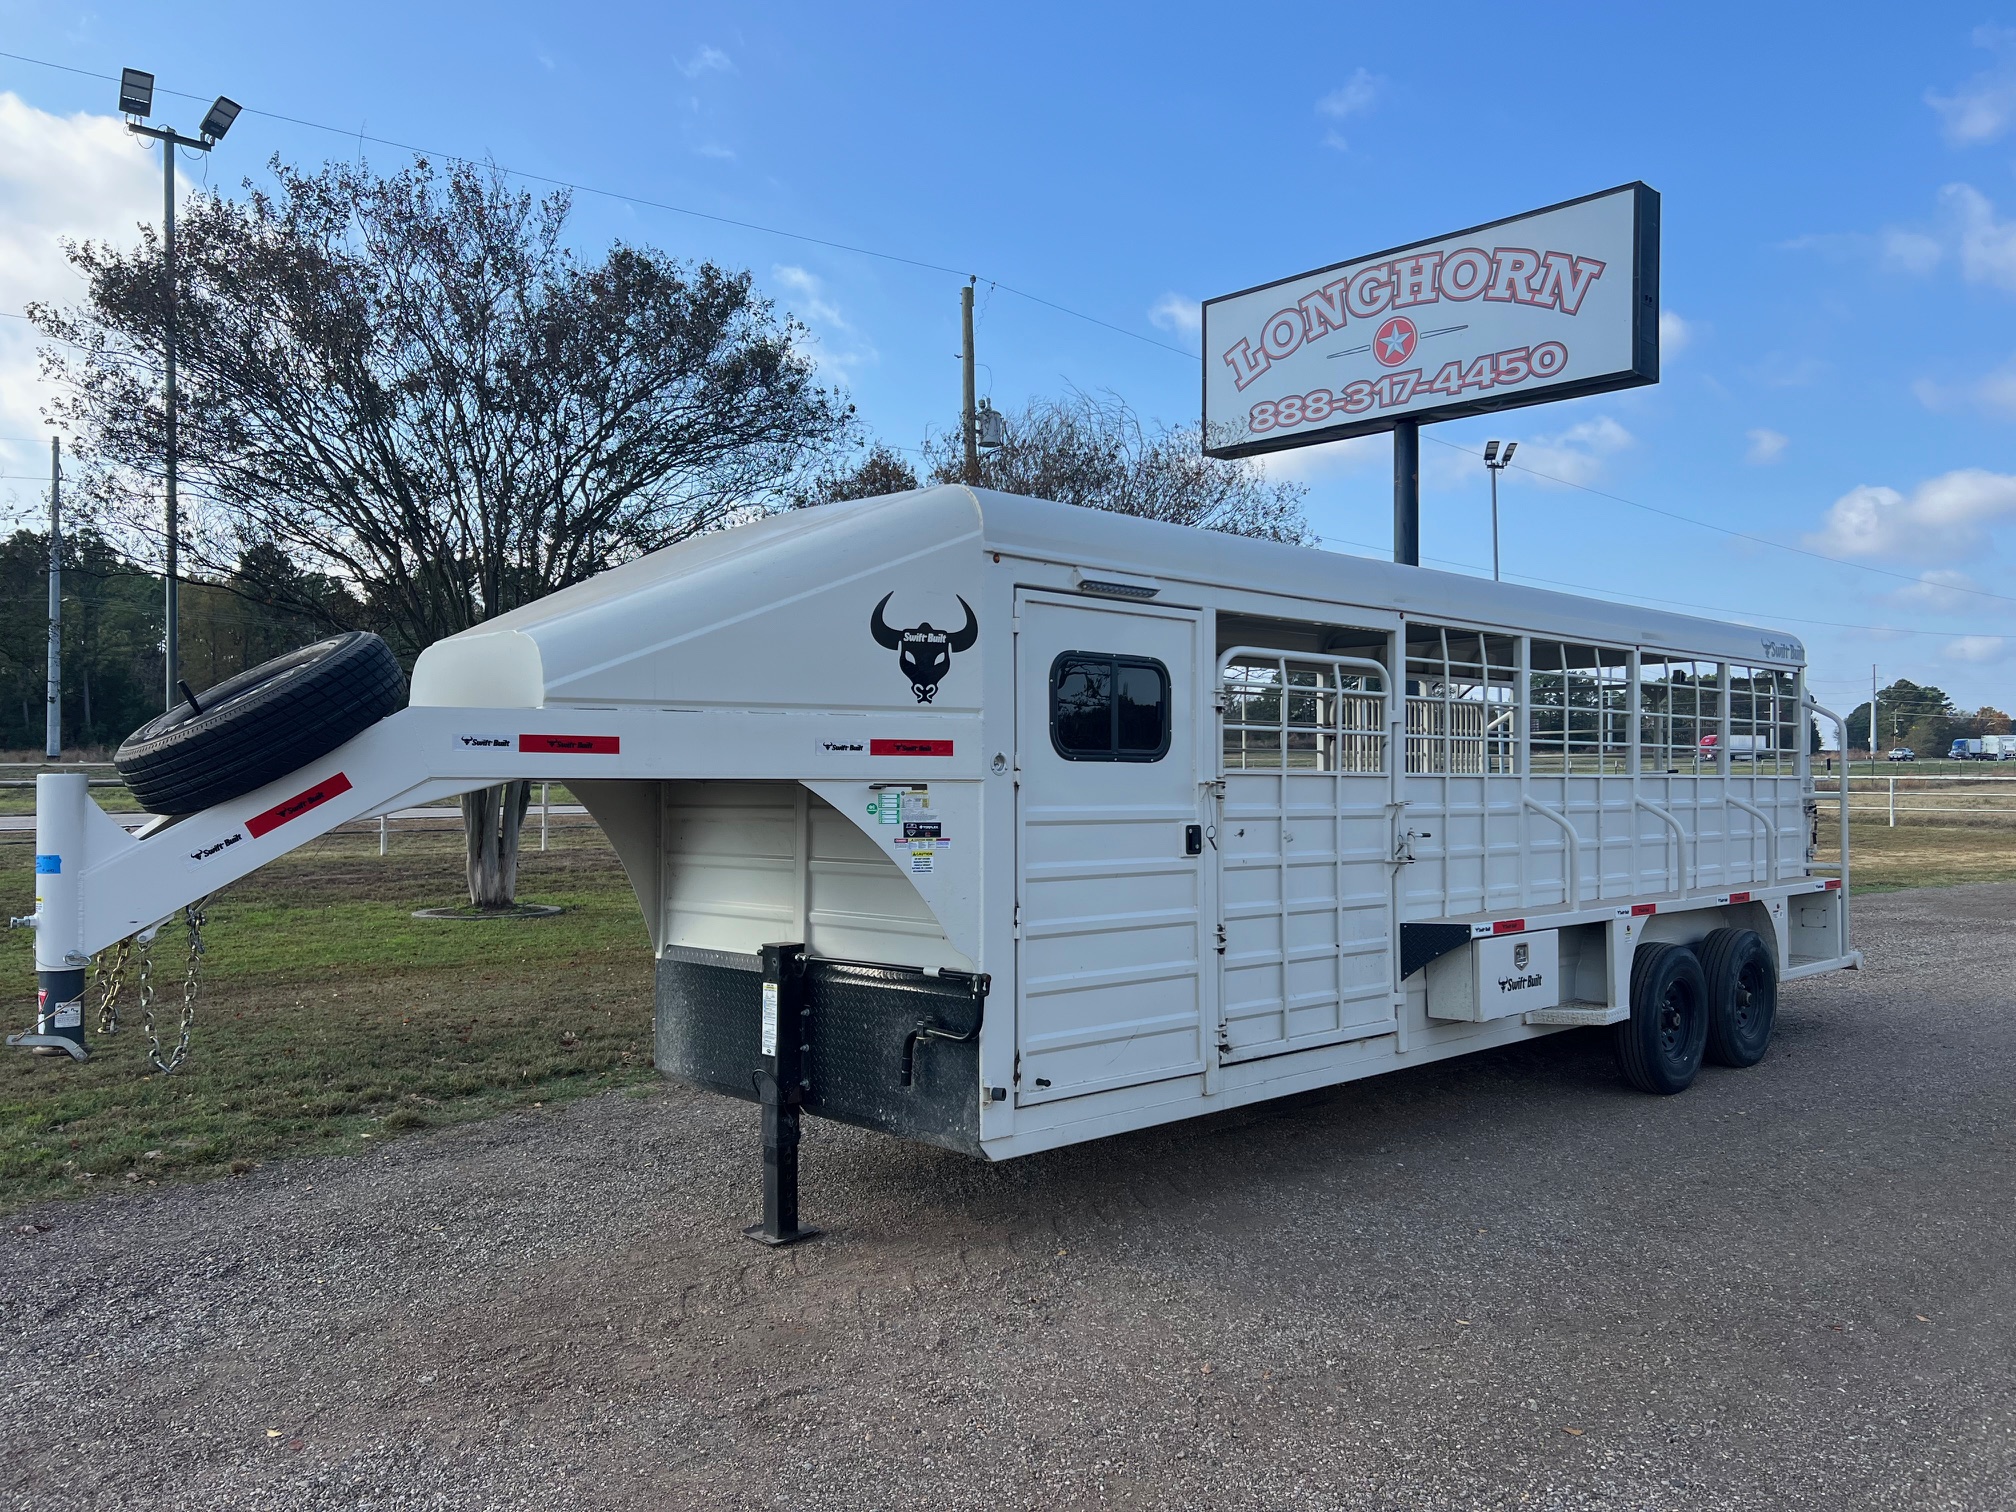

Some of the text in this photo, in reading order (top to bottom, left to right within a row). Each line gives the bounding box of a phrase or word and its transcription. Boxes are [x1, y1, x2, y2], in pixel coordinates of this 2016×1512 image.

[1223, 247, 1606, 392] LONGHORN
[1249, 341, 1568, 433] 888-317-4450
[903, 632, 947, 643] Swift Built
[472, 738, 511, 747] Swift Built
[203, 833, 243, 858] Swift Built
[1507, 974, 1542, 992] Swift Built
